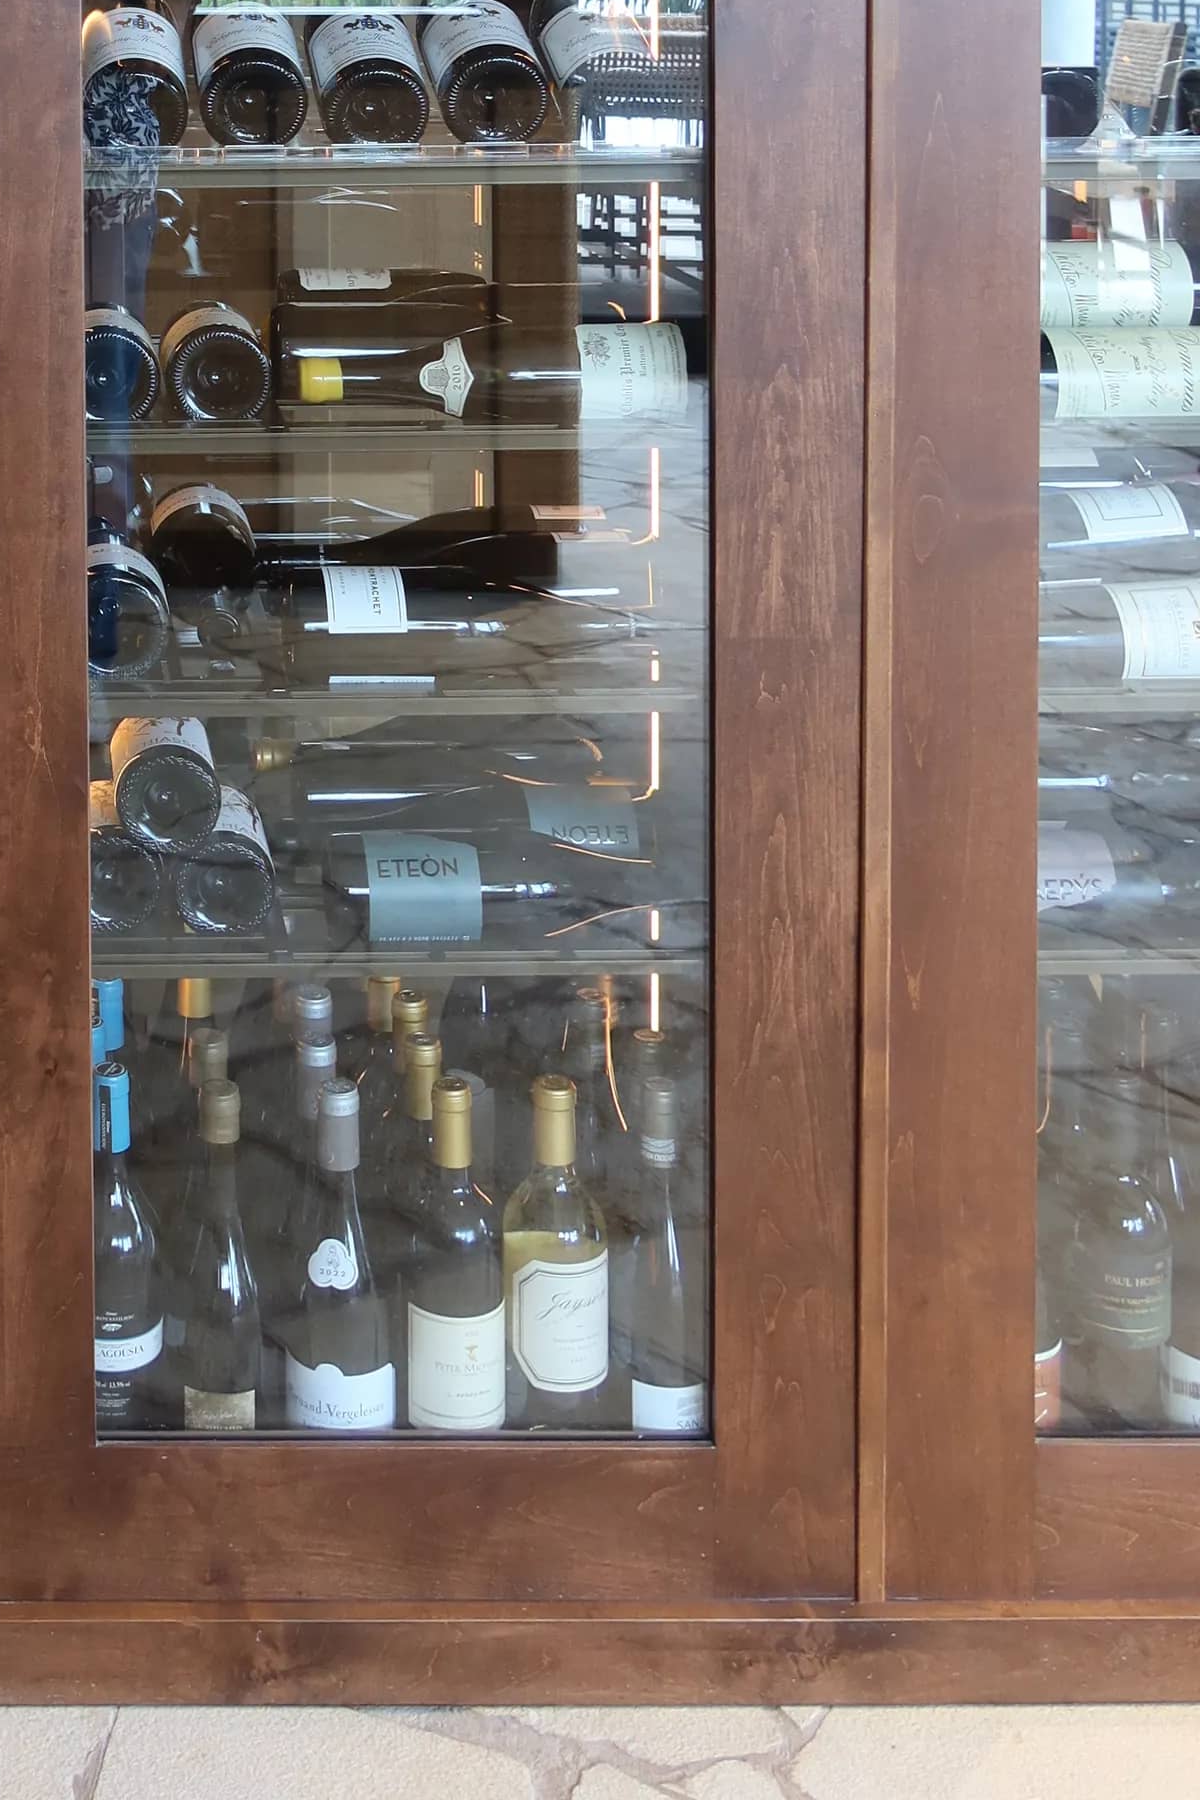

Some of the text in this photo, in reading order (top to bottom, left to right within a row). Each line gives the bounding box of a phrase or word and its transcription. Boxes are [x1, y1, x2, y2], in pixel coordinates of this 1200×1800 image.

[619, 338, 634, 376] Premier
[452, 364, 462, 392] 2010
[319, 1268, 346, 1278] 2022
